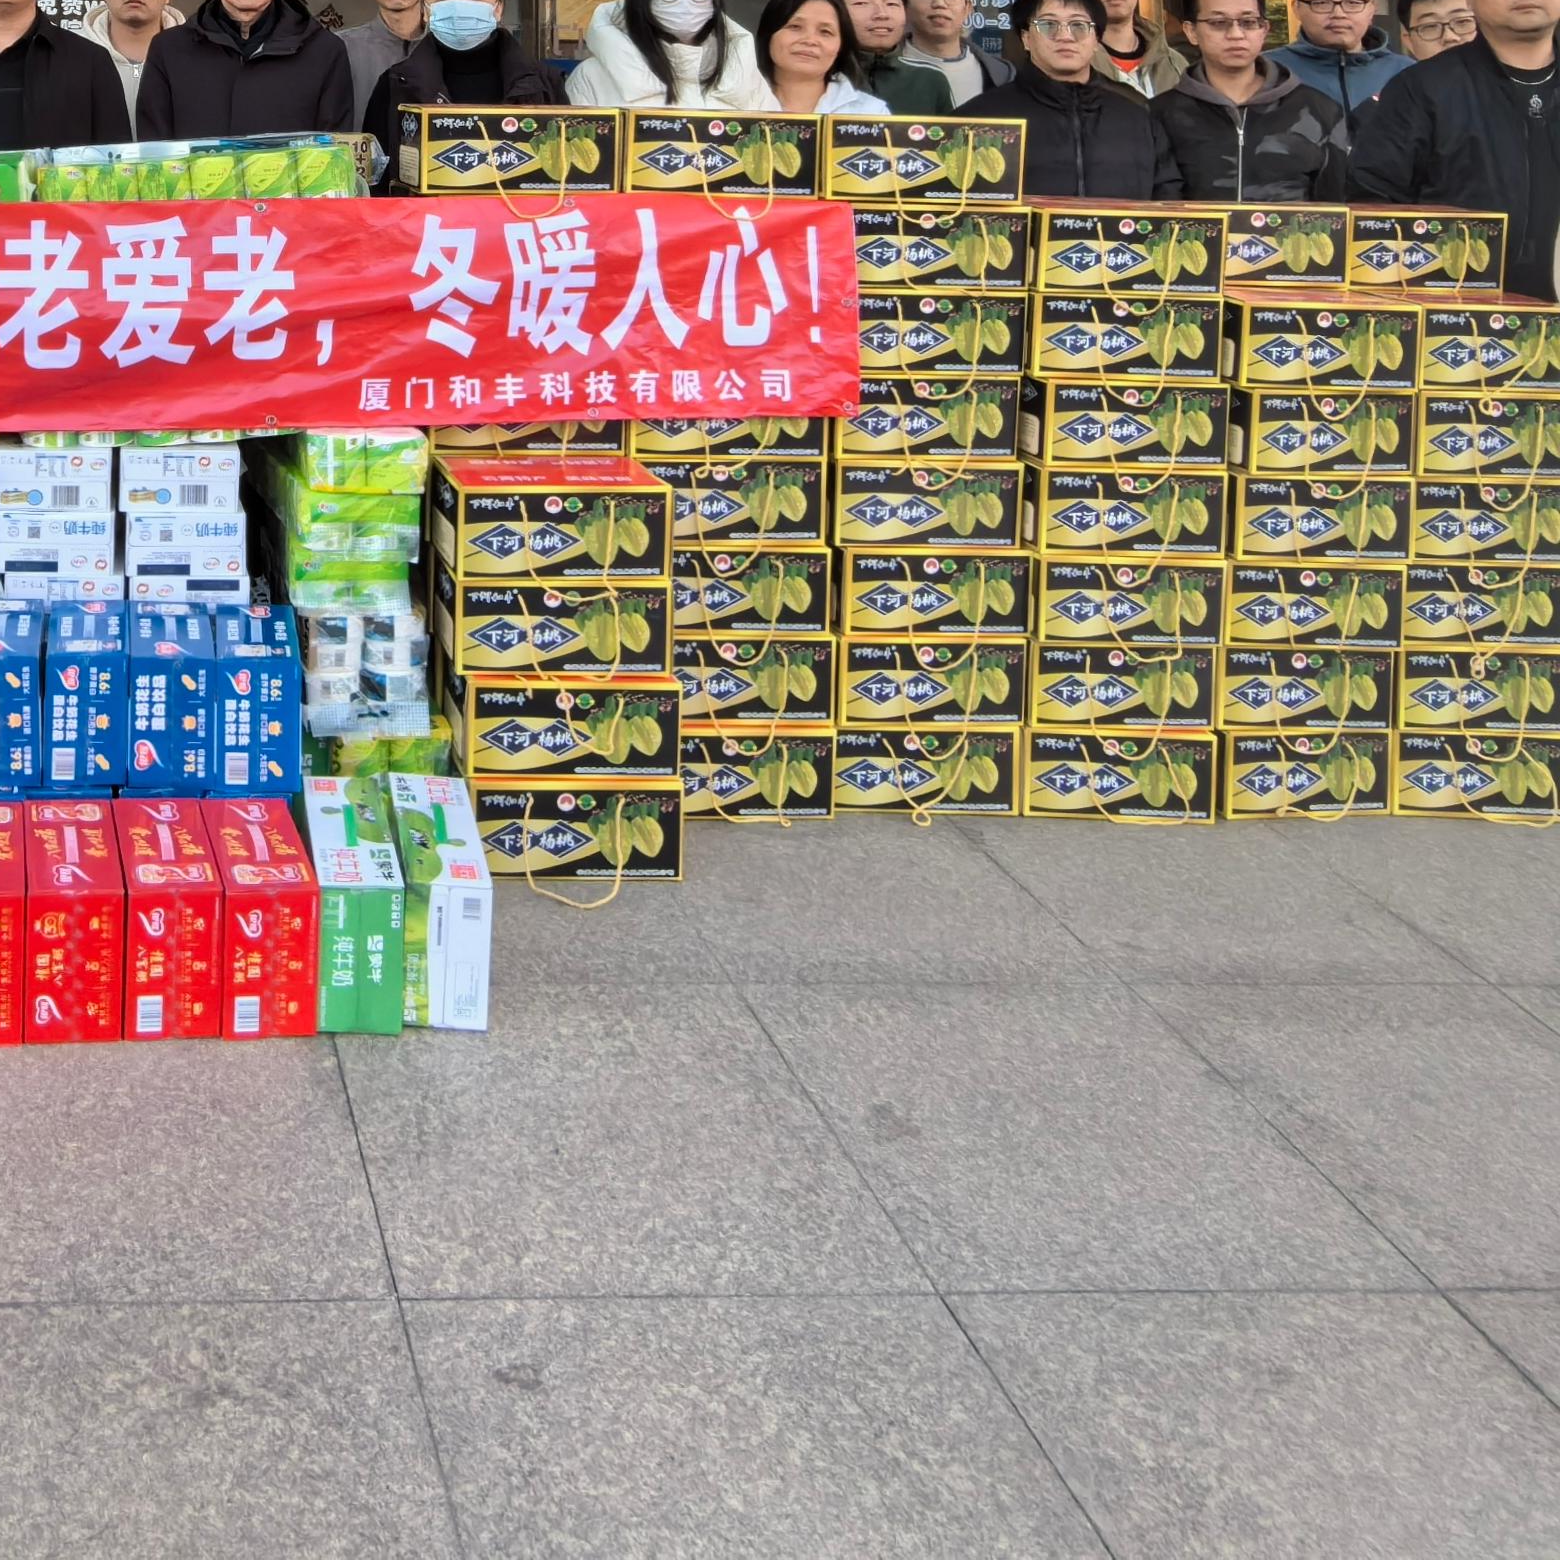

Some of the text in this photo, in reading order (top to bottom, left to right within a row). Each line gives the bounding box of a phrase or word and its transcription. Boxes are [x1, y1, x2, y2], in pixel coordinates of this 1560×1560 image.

[359, 369, 793, 411] 厦门和丰科技有限公司
[64, 521, 106, 536] 纯牛奶
[195, 522, 238, 537] 纯牛奶
[52, 695, 64, 741] 蛋白饮品
[66, 695, 78, 741] 牛奶花生
[135, 675, 150, 731] 牛奶花生
[151, 674, 167, 731] 蛋白饮品
[224, 699, 237, 746] 蛋白饮品
[238, 699, 250, 746] 牛奶花生
[331, 936, 355, 986] 纯牛奶
